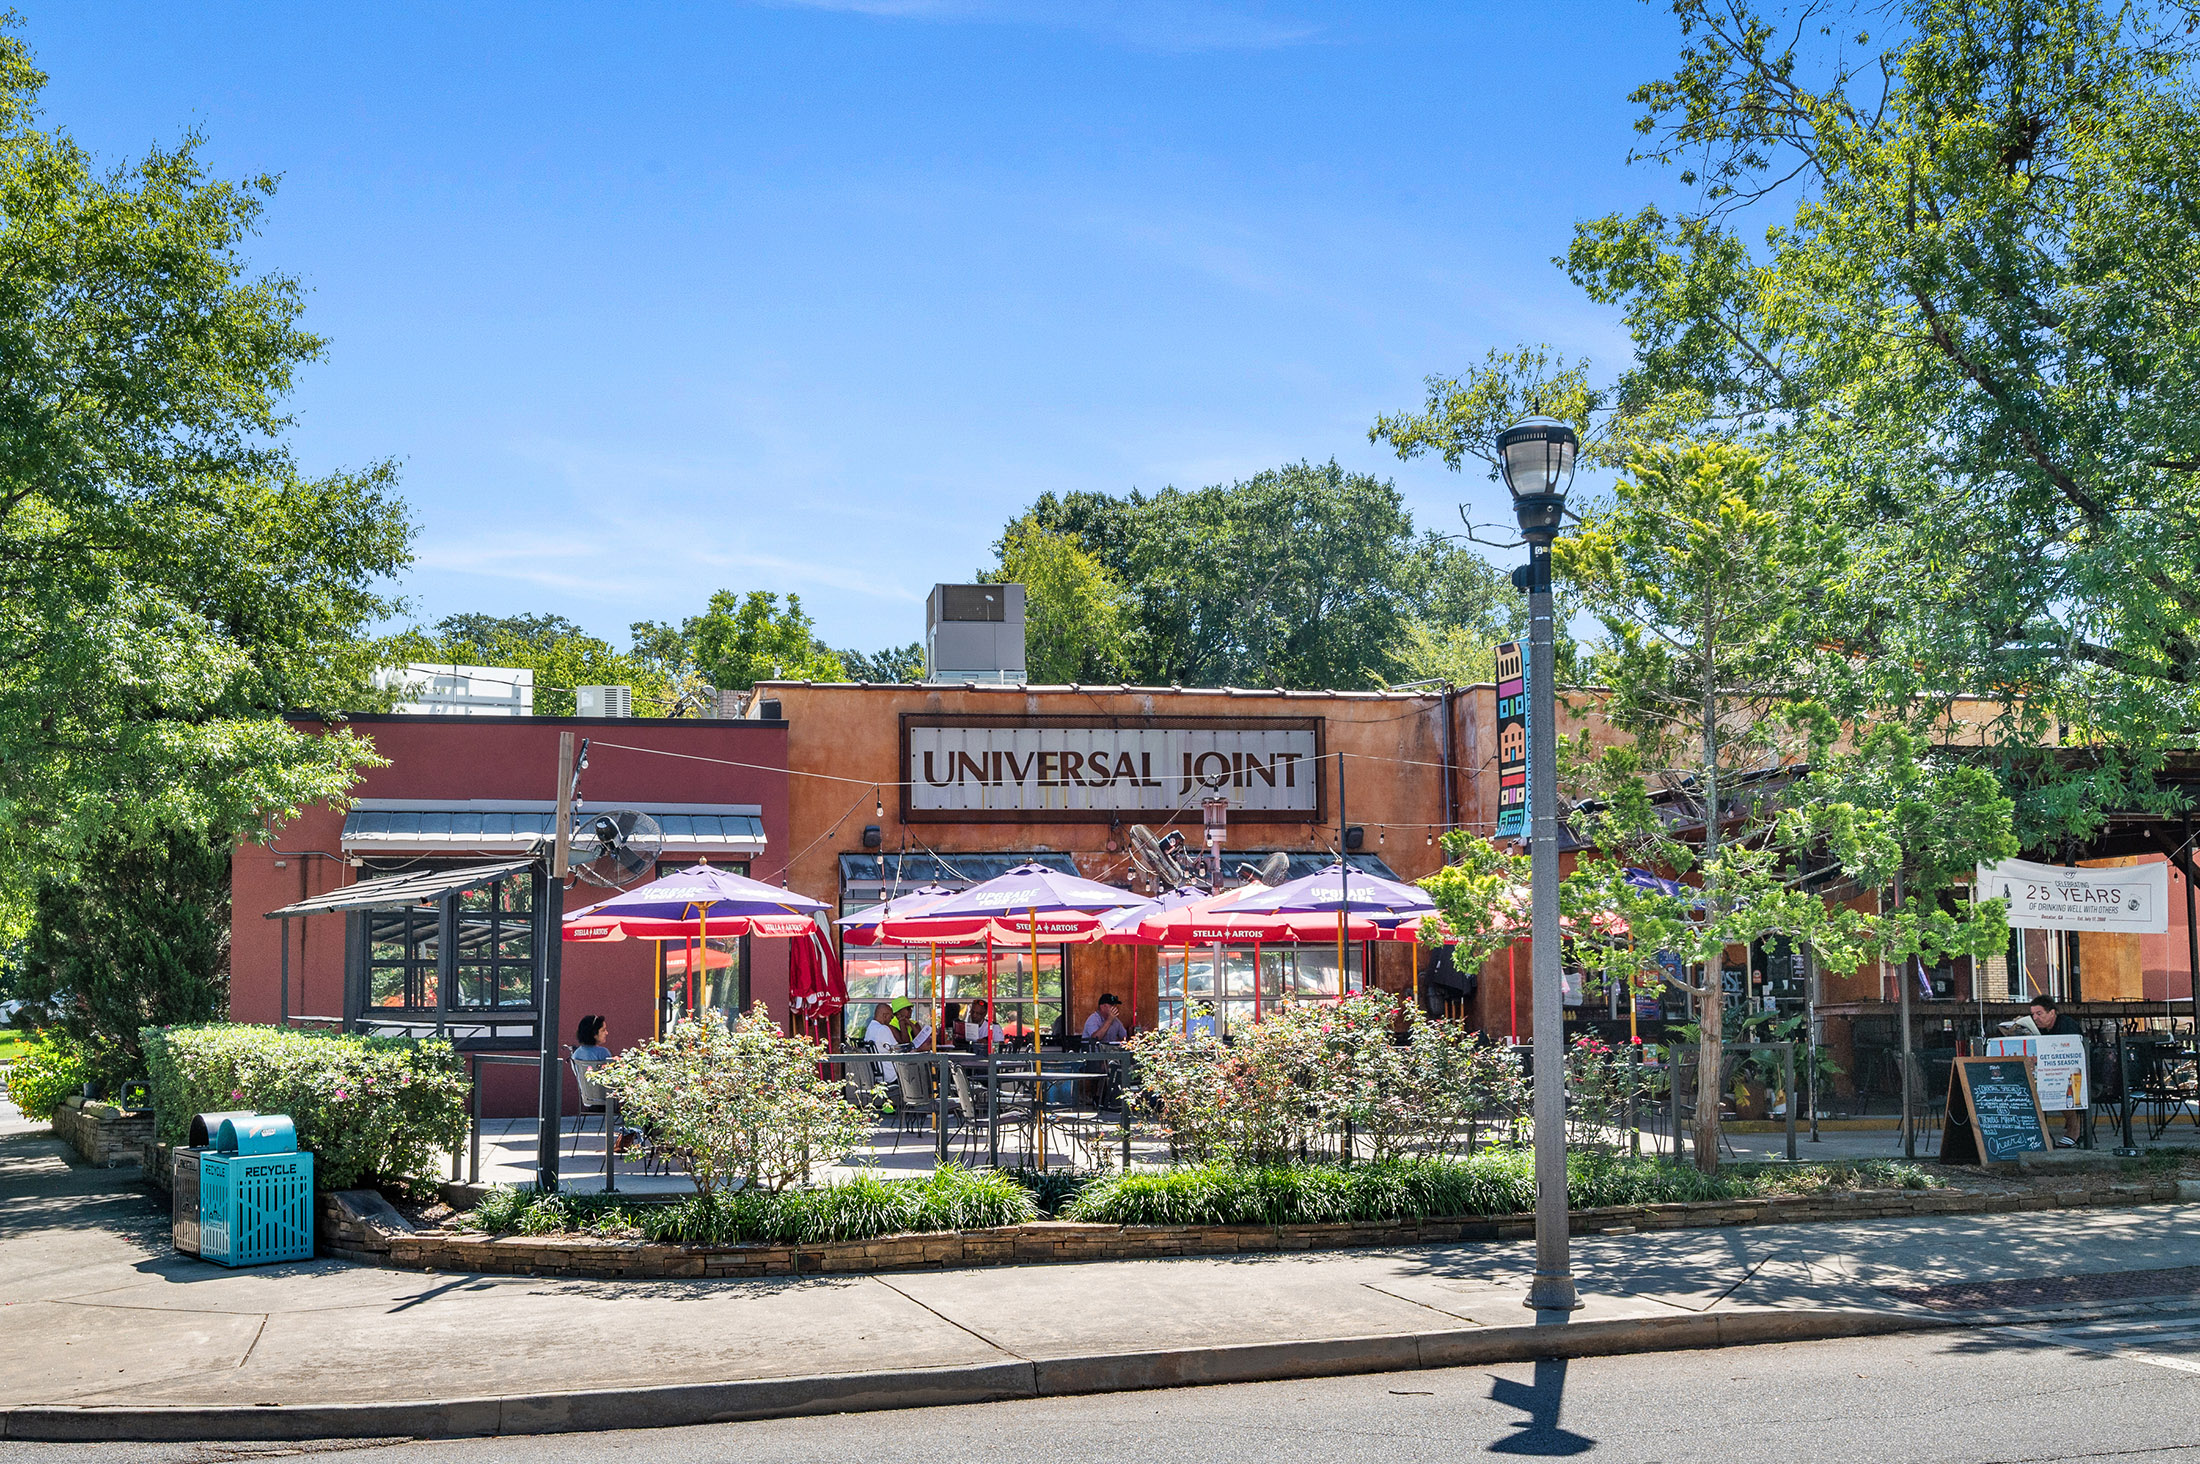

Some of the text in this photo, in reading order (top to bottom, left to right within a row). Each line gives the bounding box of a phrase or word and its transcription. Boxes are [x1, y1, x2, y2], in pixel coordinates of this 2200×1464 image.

[923, 750, 1303, 796] UNIVERSAL JOINT
[2055, 880, 2090, 888] CELEBRATING
[976, 888, 1040, 901] UPGRADE
[2026, 884, 2121, 904] 25 YEARS
[2029, 902, 2119, 914] OF DRINKING WELL WITH OTHERS
[1232, 930, 1263, 938] ARTOIS
[1988, 1133, 2027, 1155] Cheers!
[246, 1164, 296, 1177] RECYCLE
